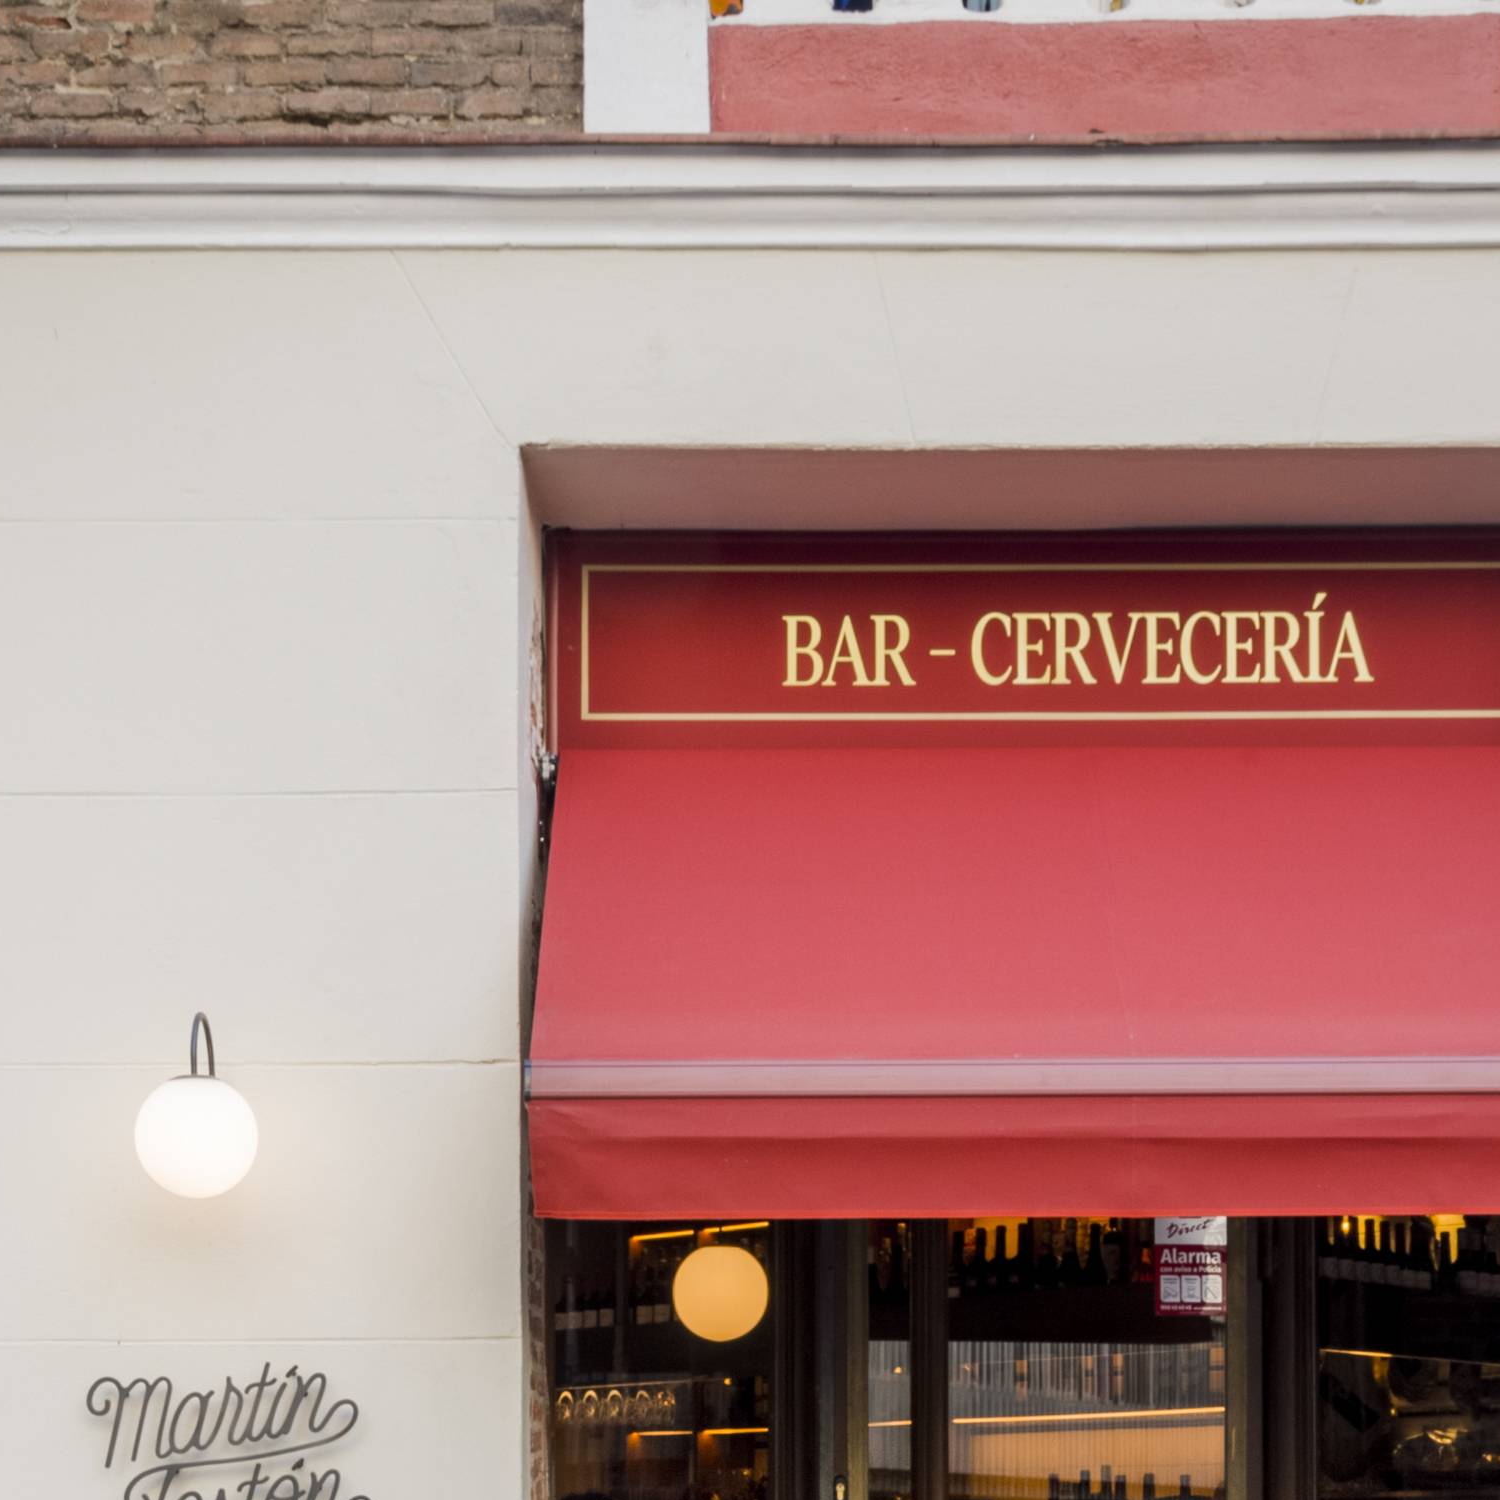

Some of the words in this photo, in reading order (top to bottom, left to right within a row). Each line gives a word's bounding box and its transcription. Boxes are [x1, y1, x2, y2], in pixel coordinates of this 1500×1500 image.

[782, 614, 916, 686] BAR
[971, 592, 1374, 686] CERVECERÍA
[1161, 1247, 1222, 1265] Alarma
[1166, 1219, 1215, 1239] Direct
[86, 1362, 359, 1468] Martín
